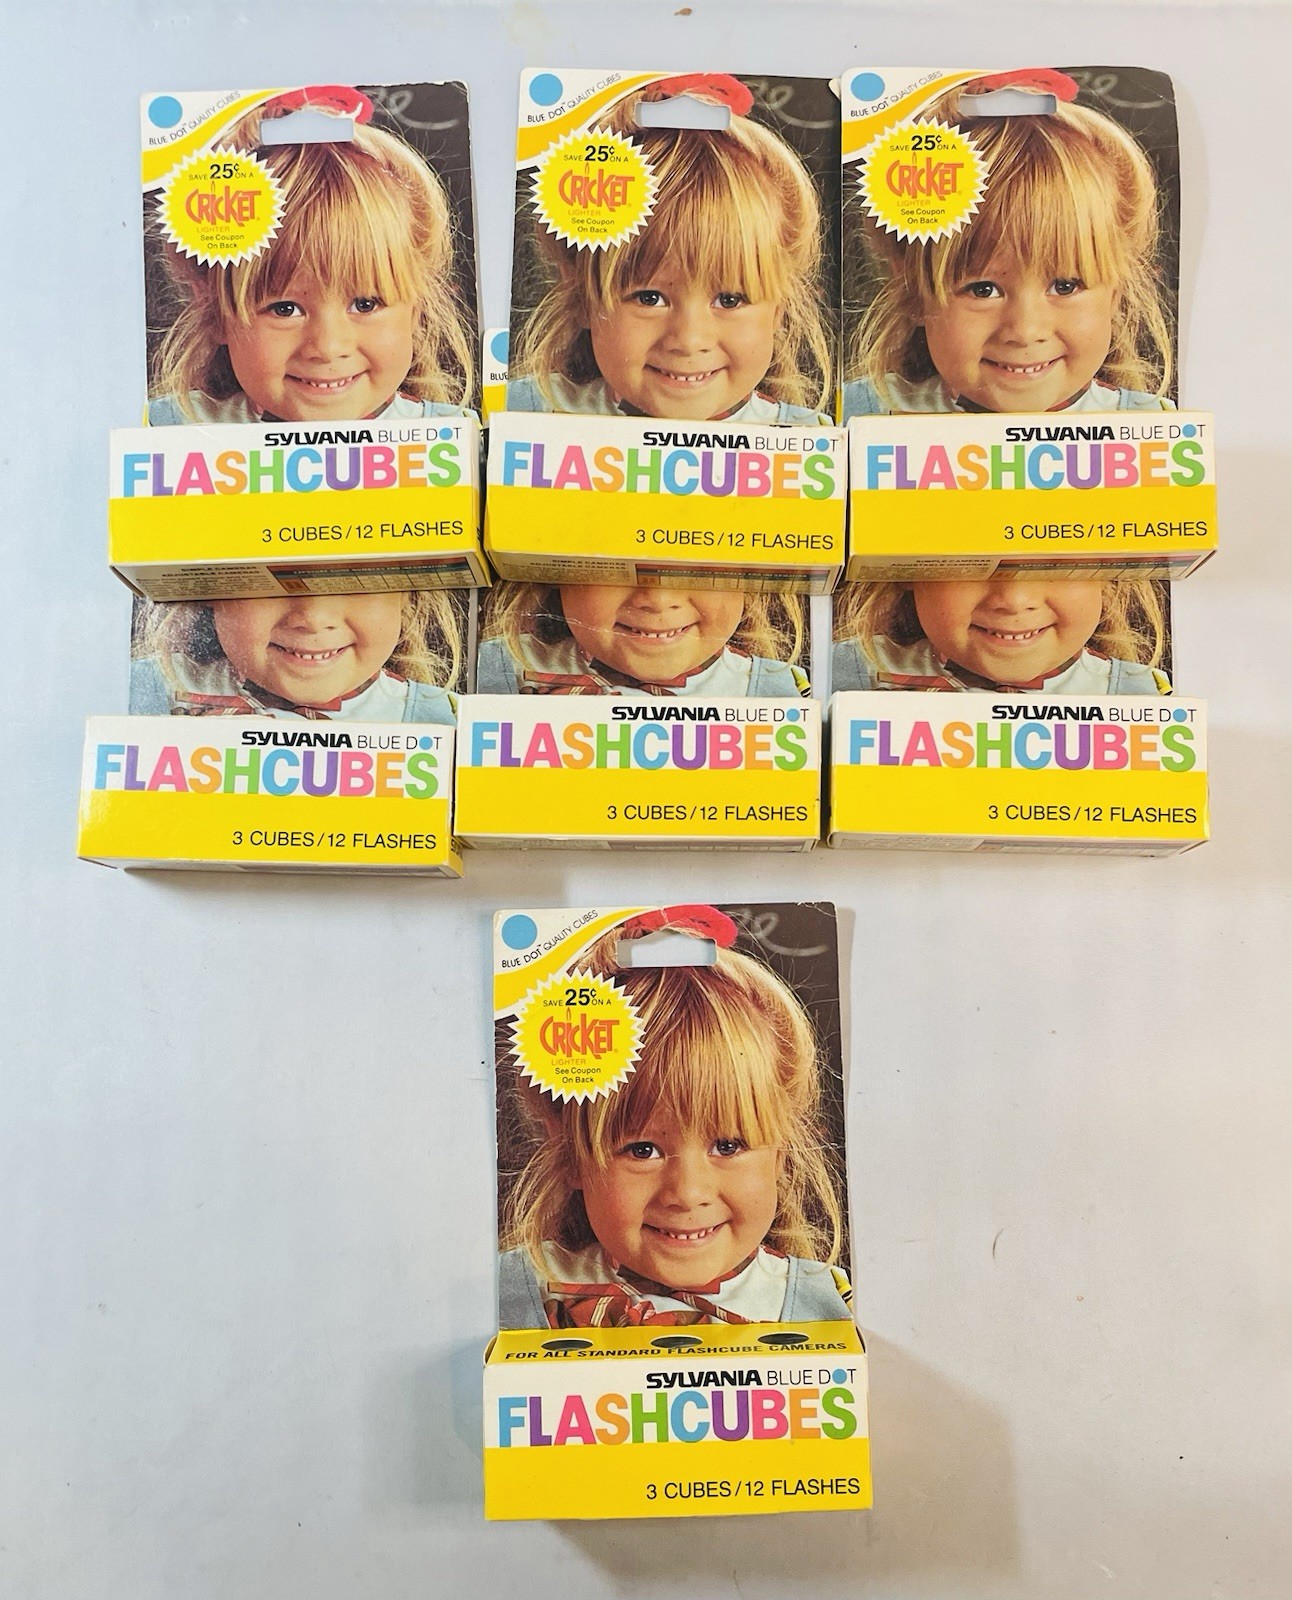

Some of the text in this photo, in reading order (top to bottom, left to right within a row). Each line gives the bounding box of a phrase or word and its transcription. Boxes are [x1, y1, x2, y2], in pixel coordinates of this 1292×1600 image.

[527, 115, 545, 123] BLUE
[567, 86, 596, 109] QUALITY
[596, 72, 621, 90] CUBES
[850, 108, 869, 117] BLUE
[890, 83, 918, 103] QUALITY
[918, 70, 943, 85] CUBES
[149, 136, 167, 145] BLUE
[189, 107, 216, 129] QUALITY
[217, 91, 241, 108] CUBES
[886, 157, 964, 201] CRICKET
[558, 169, 635, 212] CRICKET
[185, 185, 261, 227] CRICKET
[915, 208, 945, 216] Coupon
[586, 218, 615, 226] Coupon
[215, 234, 245, 242] Coupon
[264, 427, 462, 447] SYLVANIA BLUE DOT
[642, 431, 839, 453] SYLVANIA BLUE DOT
[1005, 423, 1206, 442] SYLVANIA BLUE DOT
[123, 442, 461, 498] FLASHCUBES
[502, 440, 836, 500] FLASHCUBES
[866, 440, 1206, 491] FLASHCUBES
[261, 528, 273, 543] 3
[380, 520, 464, 538] FLASHES
[636, 529, 646, 543] 3
[752, 533, 834, 550] FLASHES
[1004, 525, 1015, 540] 3
[1123, 521, 1208, 538] FLASHES
[611, 706, 810, 723] SYLVANIA BLUE DOT
[992, 705, 1198, 723] SYLVANIA BLUE DOT
[241, 731, 443, 751] SYLVANIA BLUE DOT
[471, 721, 808, 772] FLASHCUBES
[850, 719, 1197, 773] FLASHCUBES
[94, 744, 439, 799] FLASHCUBES
[607, 805, 618, 820] 3
[725, 806, 808, 822] FLASHES
[988, 805, 999, 820] 3
[1110, 807, 1198, 823] FLASHES
[232, 831, 243, 846] 3
[353, 833, 437, 850] FLASHES
[501, 957, 521, 968] BLUE
[543, 925, 572, 951] QUALITY
[572, 909, 599, 929] CUBES
[543, 999, 563, 1007] SAVE
[539, 1013, 620, 1060] CRICKET
[555, 1067, 601, 1075] See Coupon
[505, 1342, 848, 1360] FOR ALL STANDARD FLASHCUBE CAMERAS
[646, 1368, 857, 1389] SYLVANIA BLUE DOT
[498, 1386, 858, 1448] FLASHCUBES
[646, 1484, 658, 1500] 3
[771, 1478, 861, 1495] FLASHES
